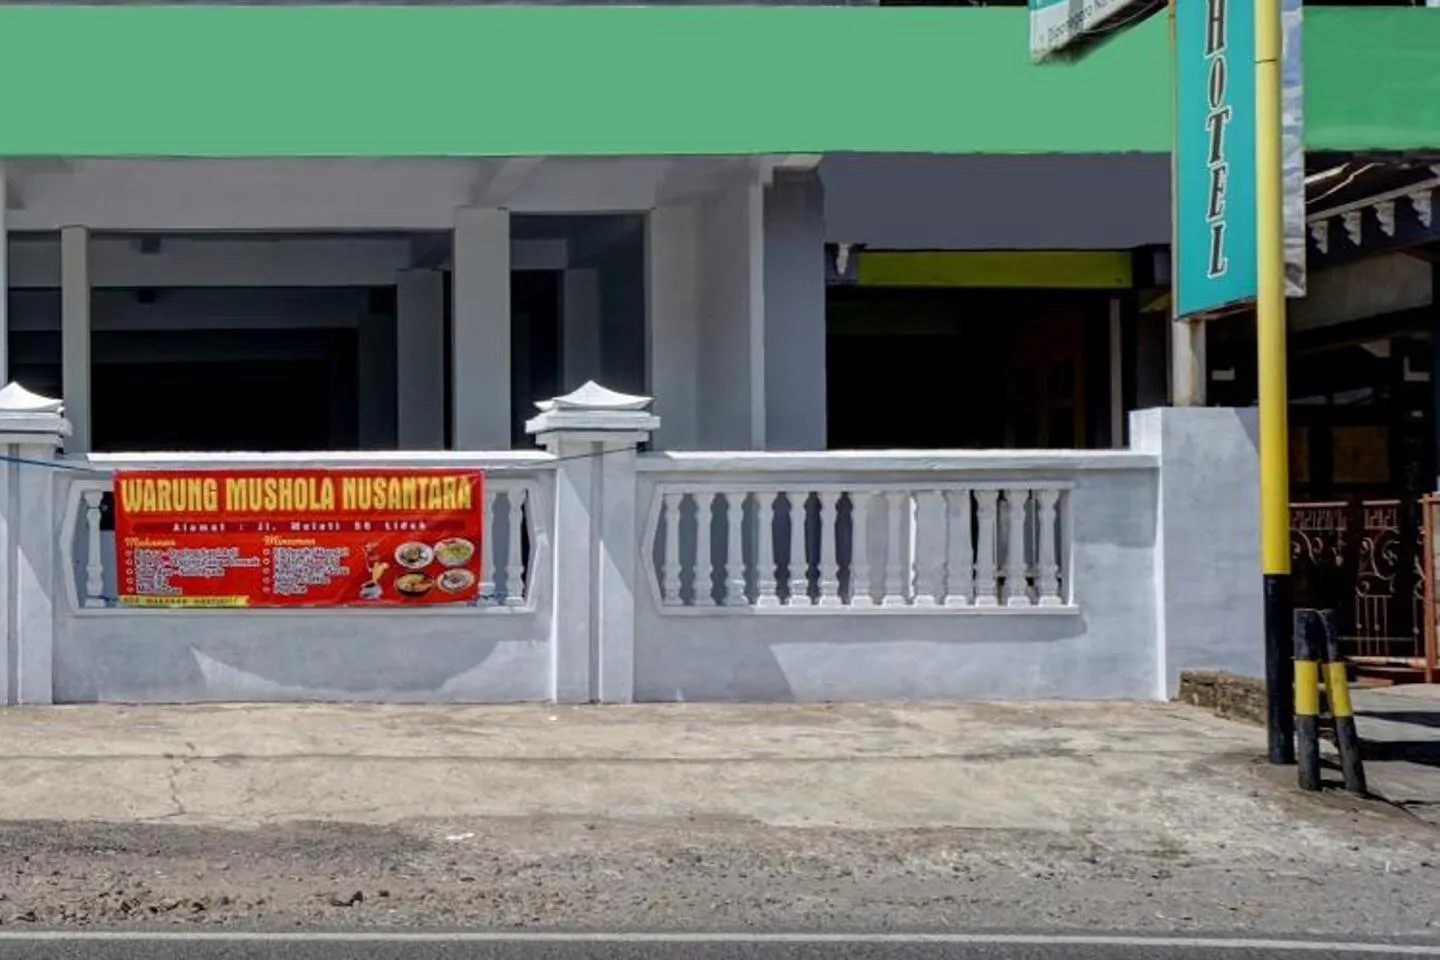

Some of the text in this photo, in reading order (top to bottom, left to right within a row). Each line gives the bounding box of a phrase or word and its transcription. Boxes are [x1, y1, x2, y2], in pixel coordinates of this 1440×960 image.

[120, 475, 472, 513] WARUNG MUSHOLA NUSANTARA
